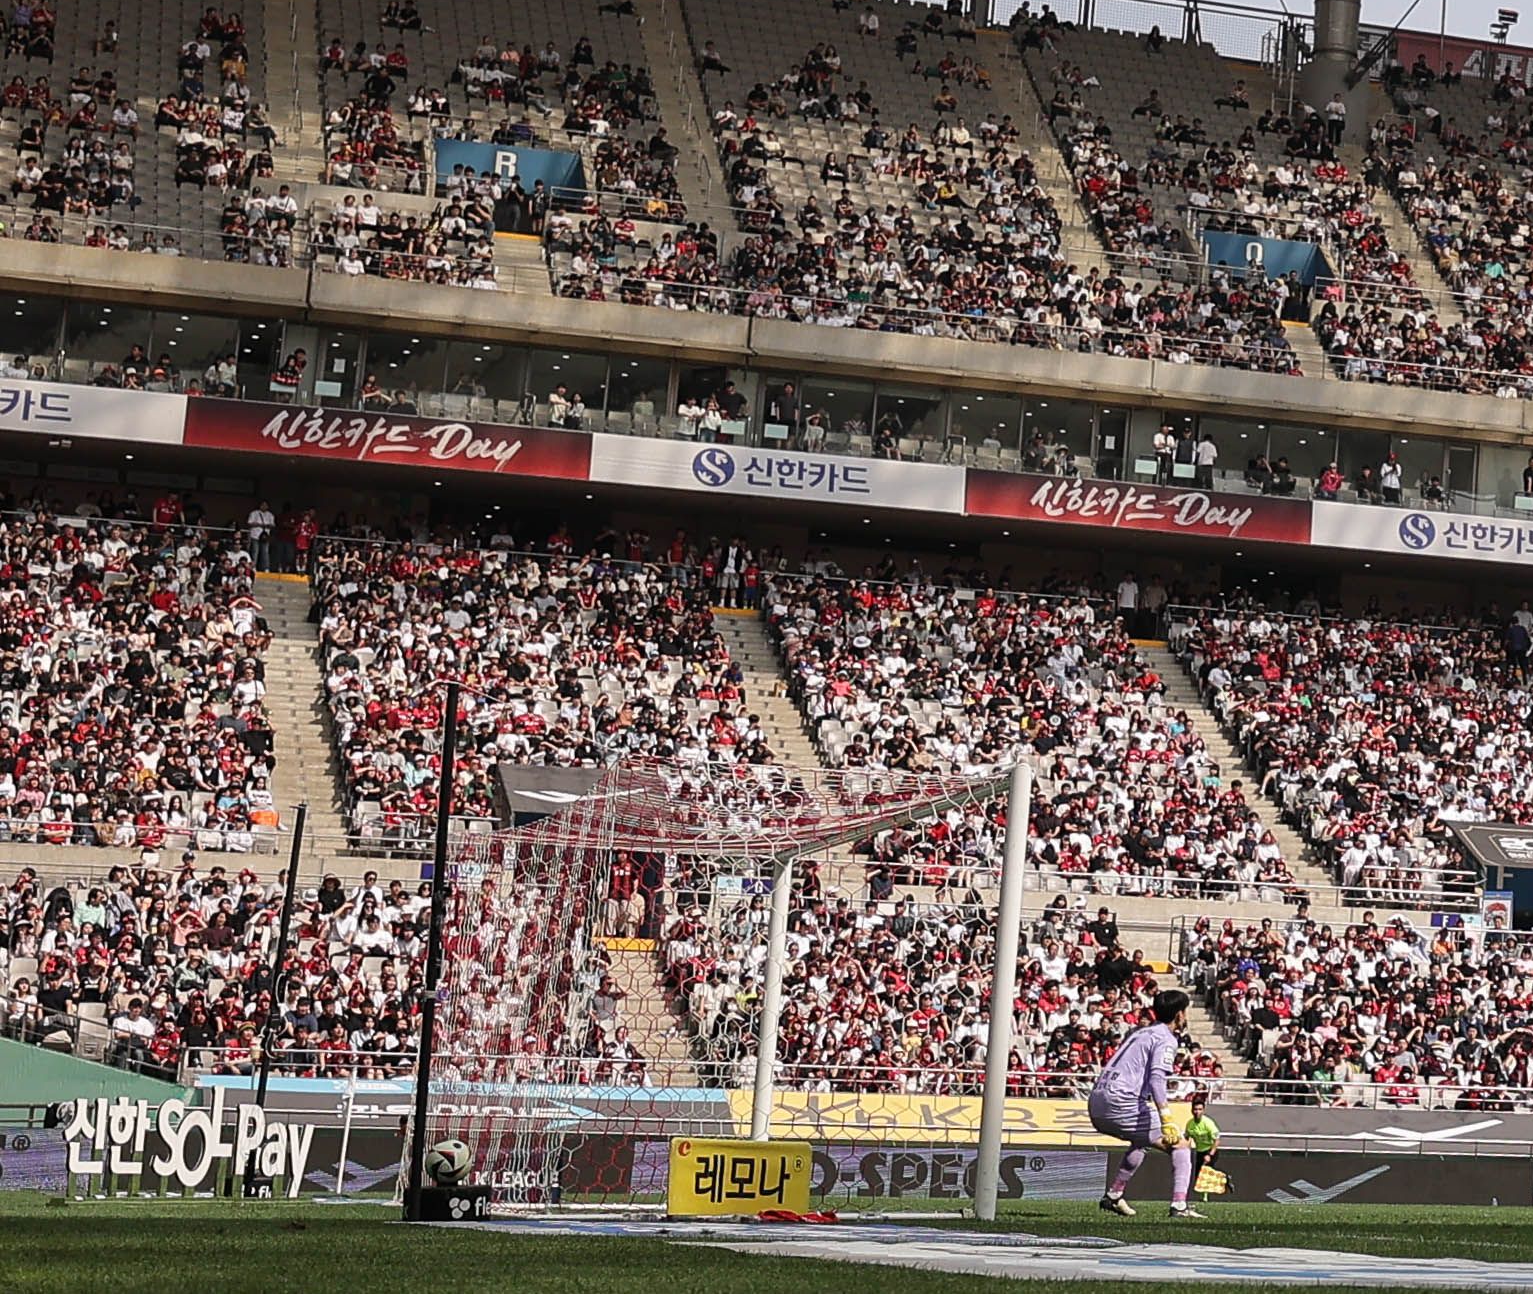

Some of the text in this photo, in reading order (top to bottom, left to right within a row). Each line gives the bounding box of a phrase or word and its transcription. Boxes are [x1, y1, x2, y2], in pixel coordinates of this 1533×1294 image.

[495, 151, 517, 177] R
[421, 422, 523, 473] Day
[744, 457, 871, 495] 신한카드
[1173, 491, 1253, 537] Day
[63, 1086, 315, 1198] 신한 SOL Pay
